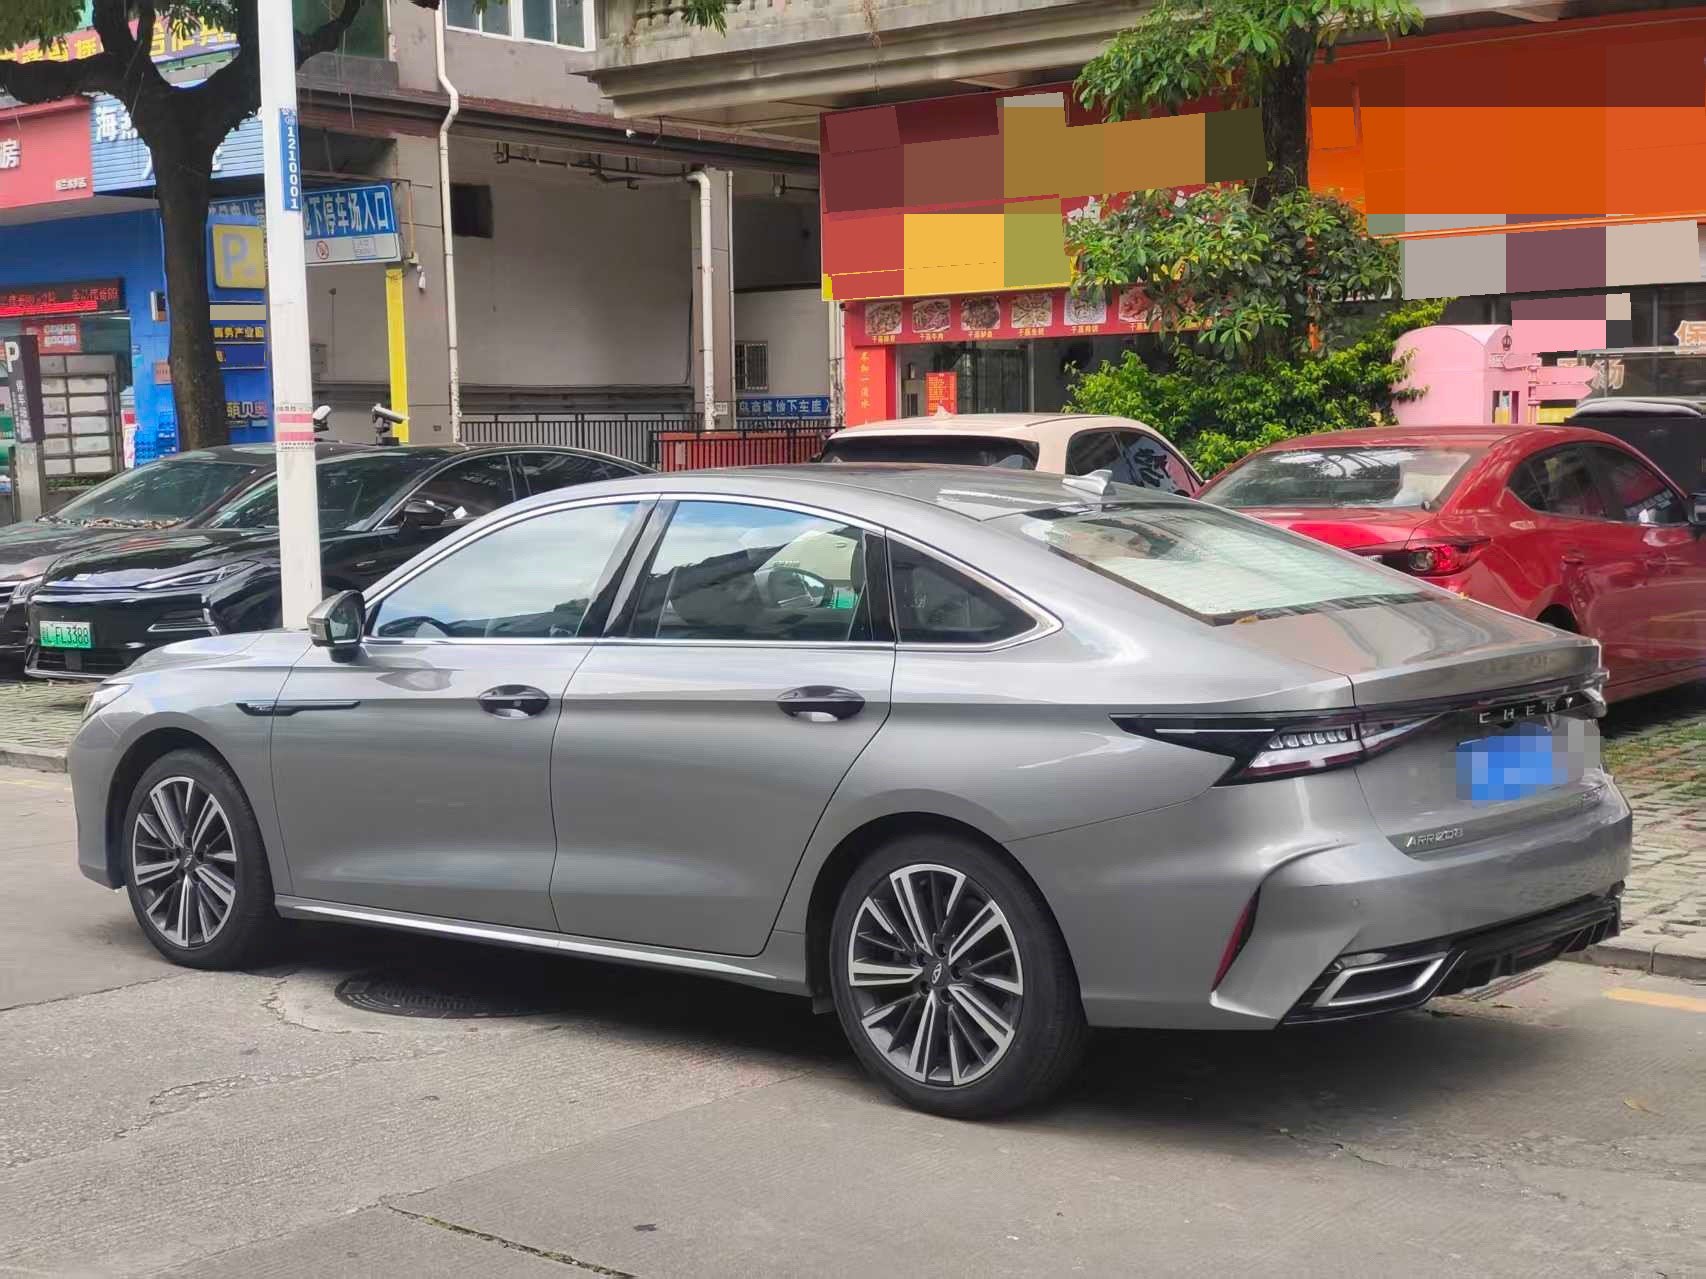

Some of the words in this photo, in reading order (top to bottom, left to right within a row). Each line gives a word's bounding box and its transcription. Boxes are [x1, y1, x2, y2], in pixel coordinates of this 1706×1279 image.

[287, 126, 299, 209] 1210001
[4, 341, 20, 373] P
[1479, 697, 1574, 724] CHERY
